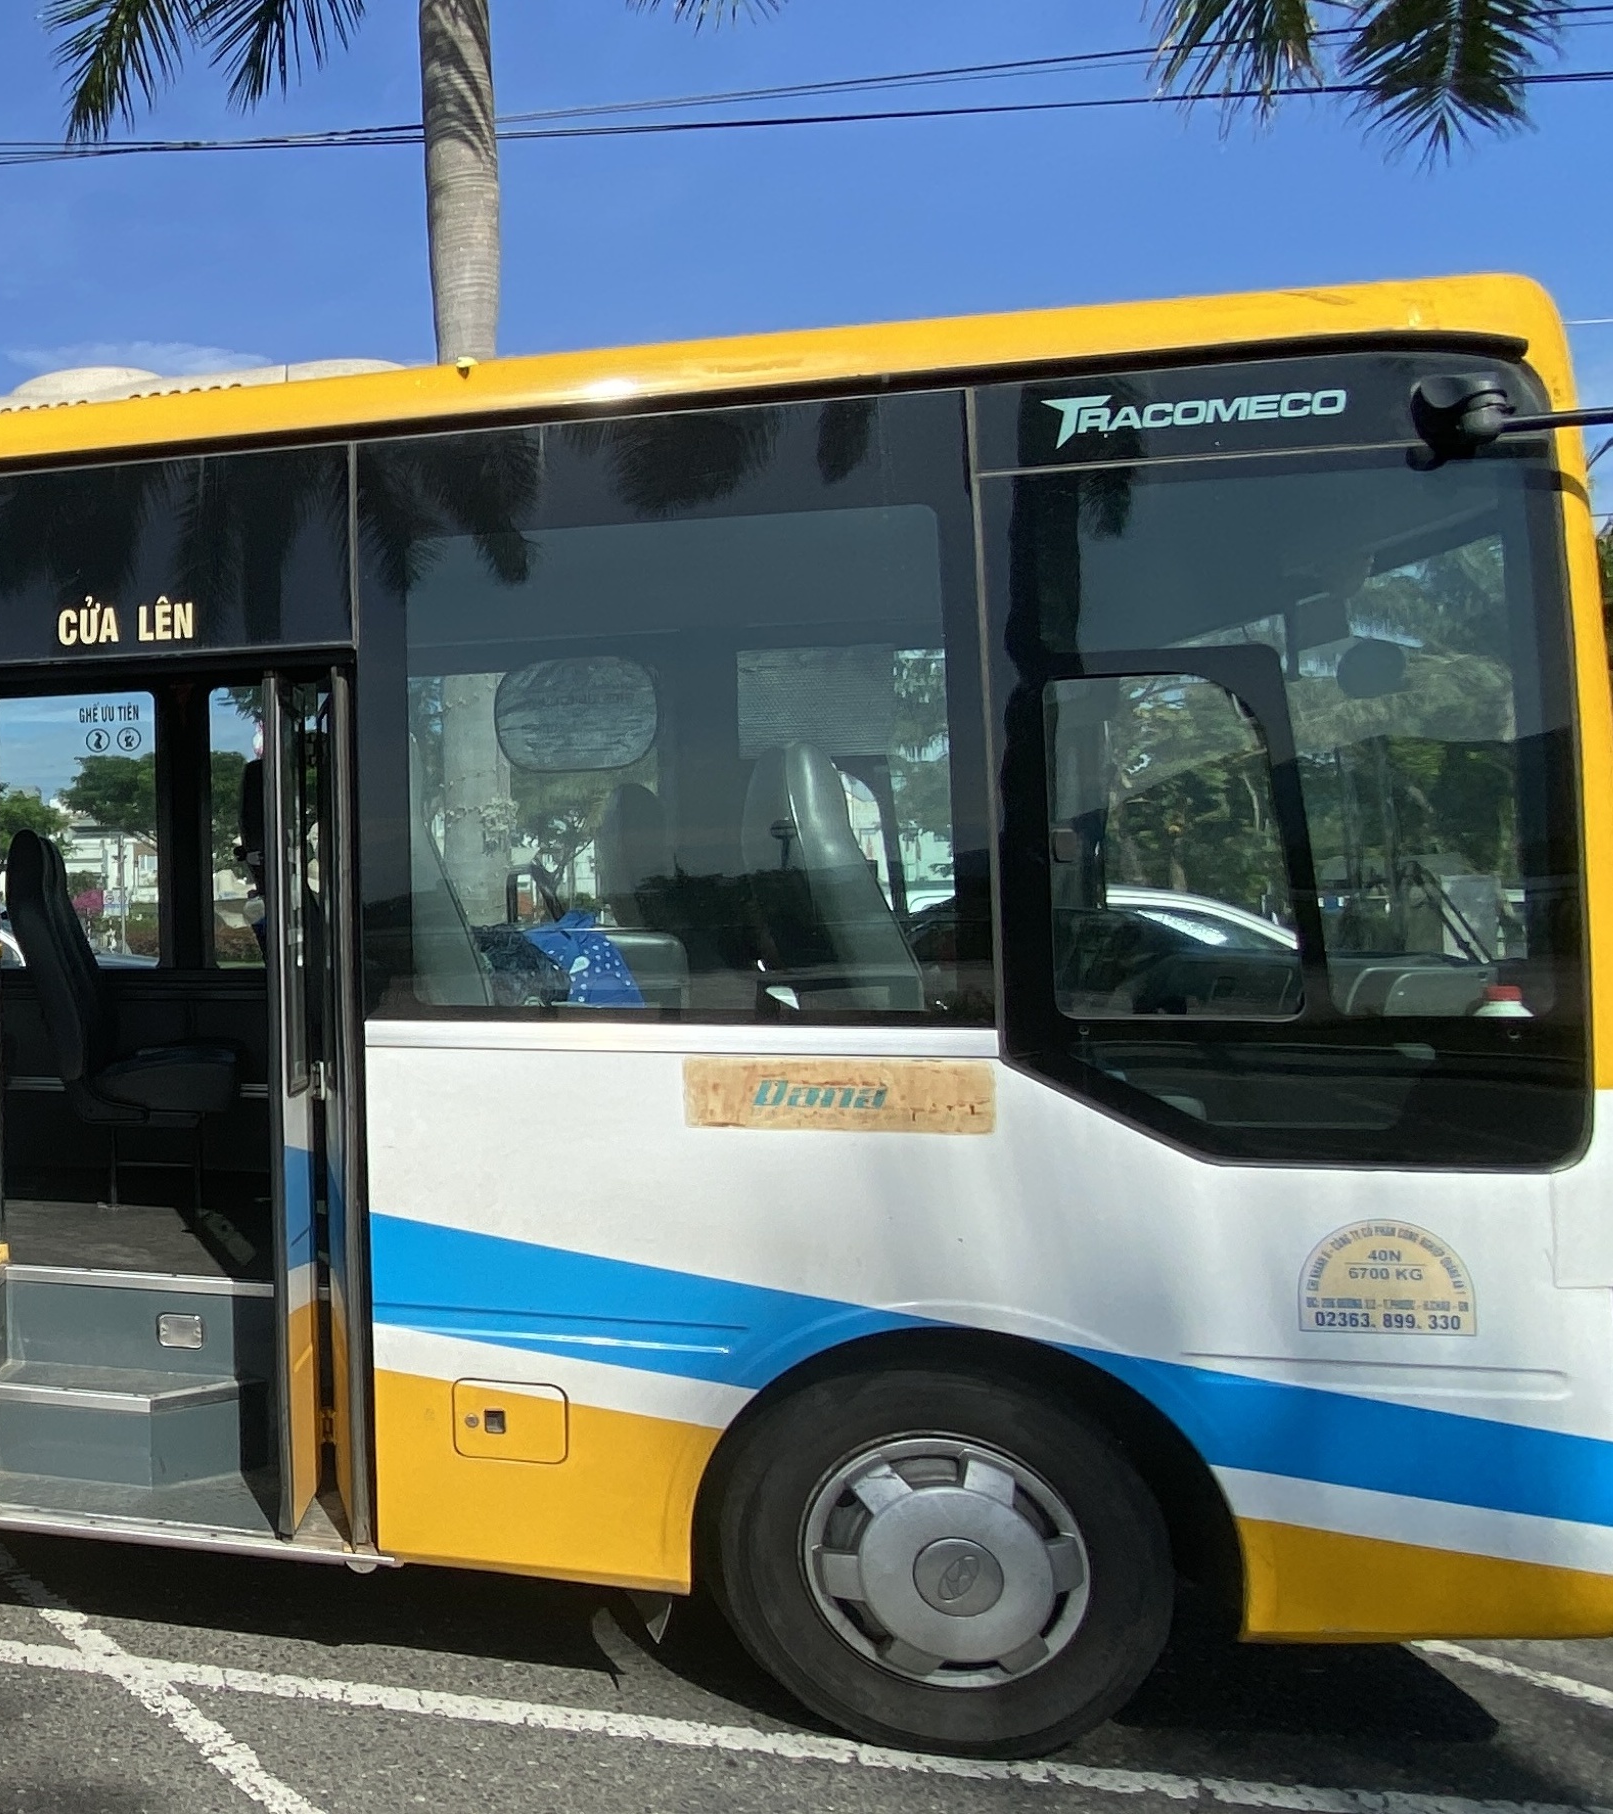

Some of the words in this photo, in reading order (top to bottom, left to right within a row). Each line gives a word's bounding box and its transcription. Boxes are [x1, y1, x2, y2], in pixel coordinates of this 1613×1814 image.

[1040, 389, 1347, 450] TRACOMECO
[58, 596, 119, 645] CỬA
[138, 596, 193, 641] LÊN
[117, 702, 139, 721] TIÊN
[753, 1080, 888, 1109] Dana
[1368, 1250, 1402, 1263] 40N
[1348, 1267, 1391, 1280] 6700
[1395, 1268, 1424, 1281] KG
[1314, 1311, 1376, 1328] 02363.
[1383, 1314, 1422, 1329] 899.
[1428, 1315, 1462, 1330] 330
